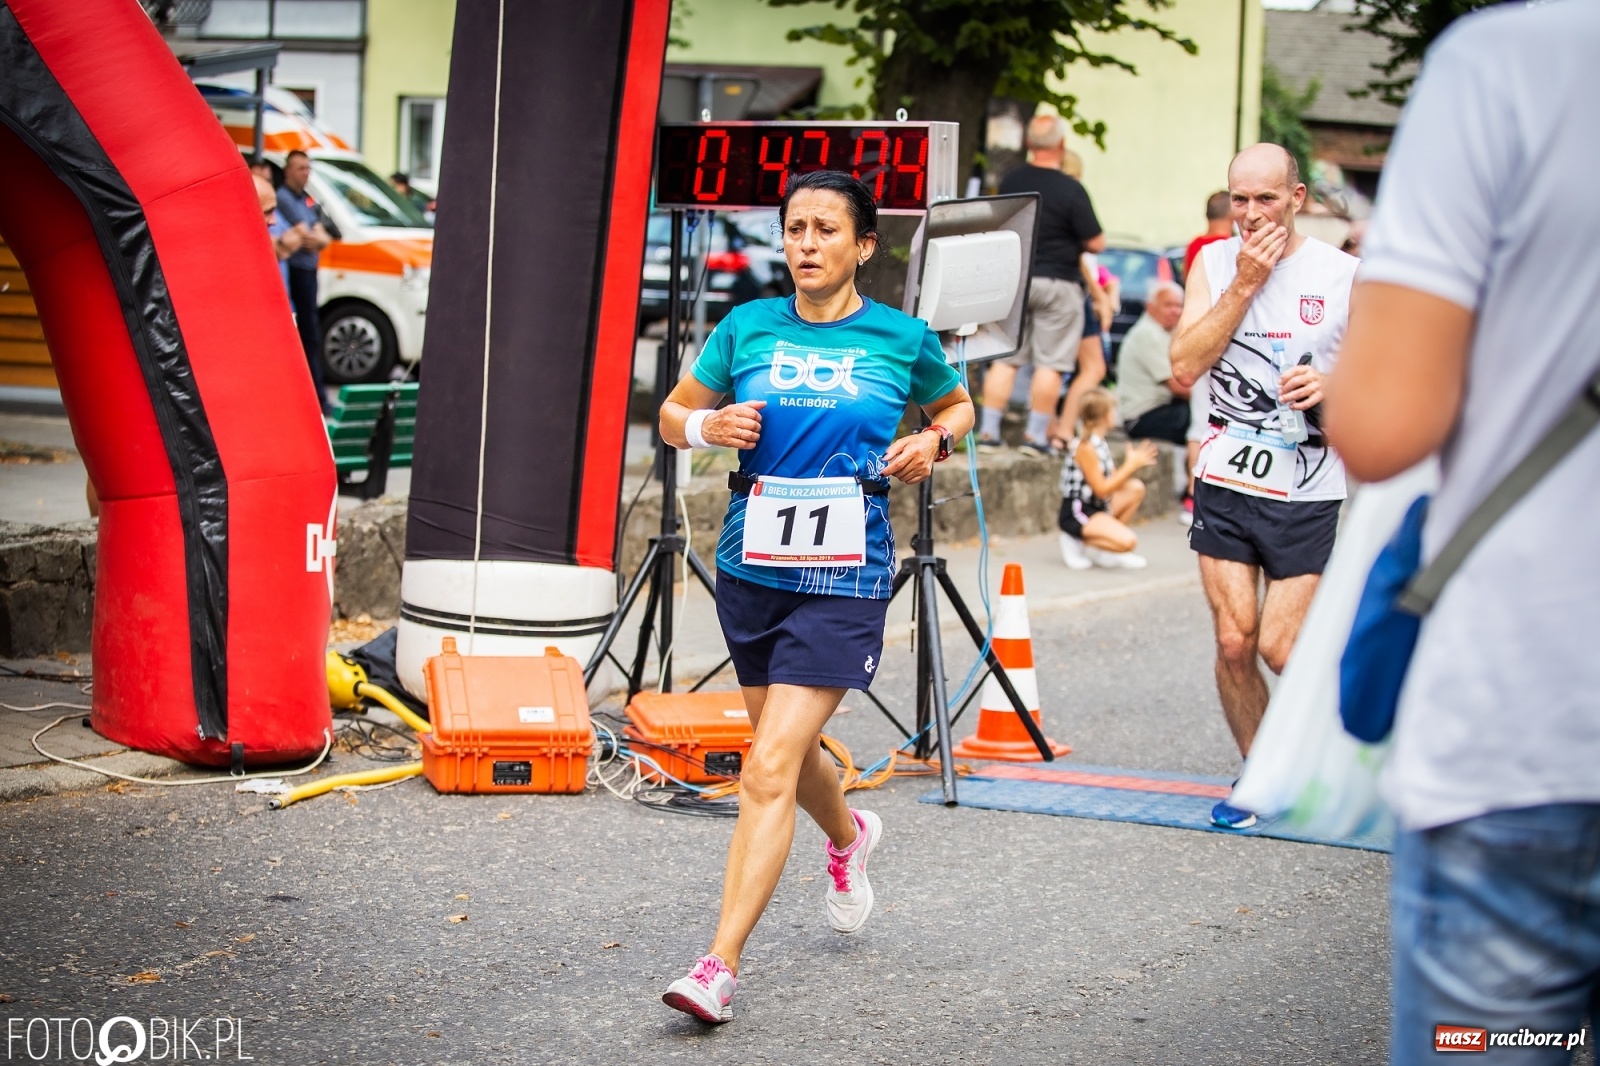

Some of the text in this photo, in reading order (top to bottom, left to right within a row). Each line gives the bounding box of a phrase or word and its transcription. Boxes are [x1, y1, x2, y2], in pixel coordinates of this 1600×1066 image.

[780, 397, 838, 409] RACIBÓRZ
[1227, 445, 1273, 479] 40
[768, 486, 788, 496] BIEG
[790, 485, 856, 497] KRZANOWICKI
[776, 505, 830, 546] 11
